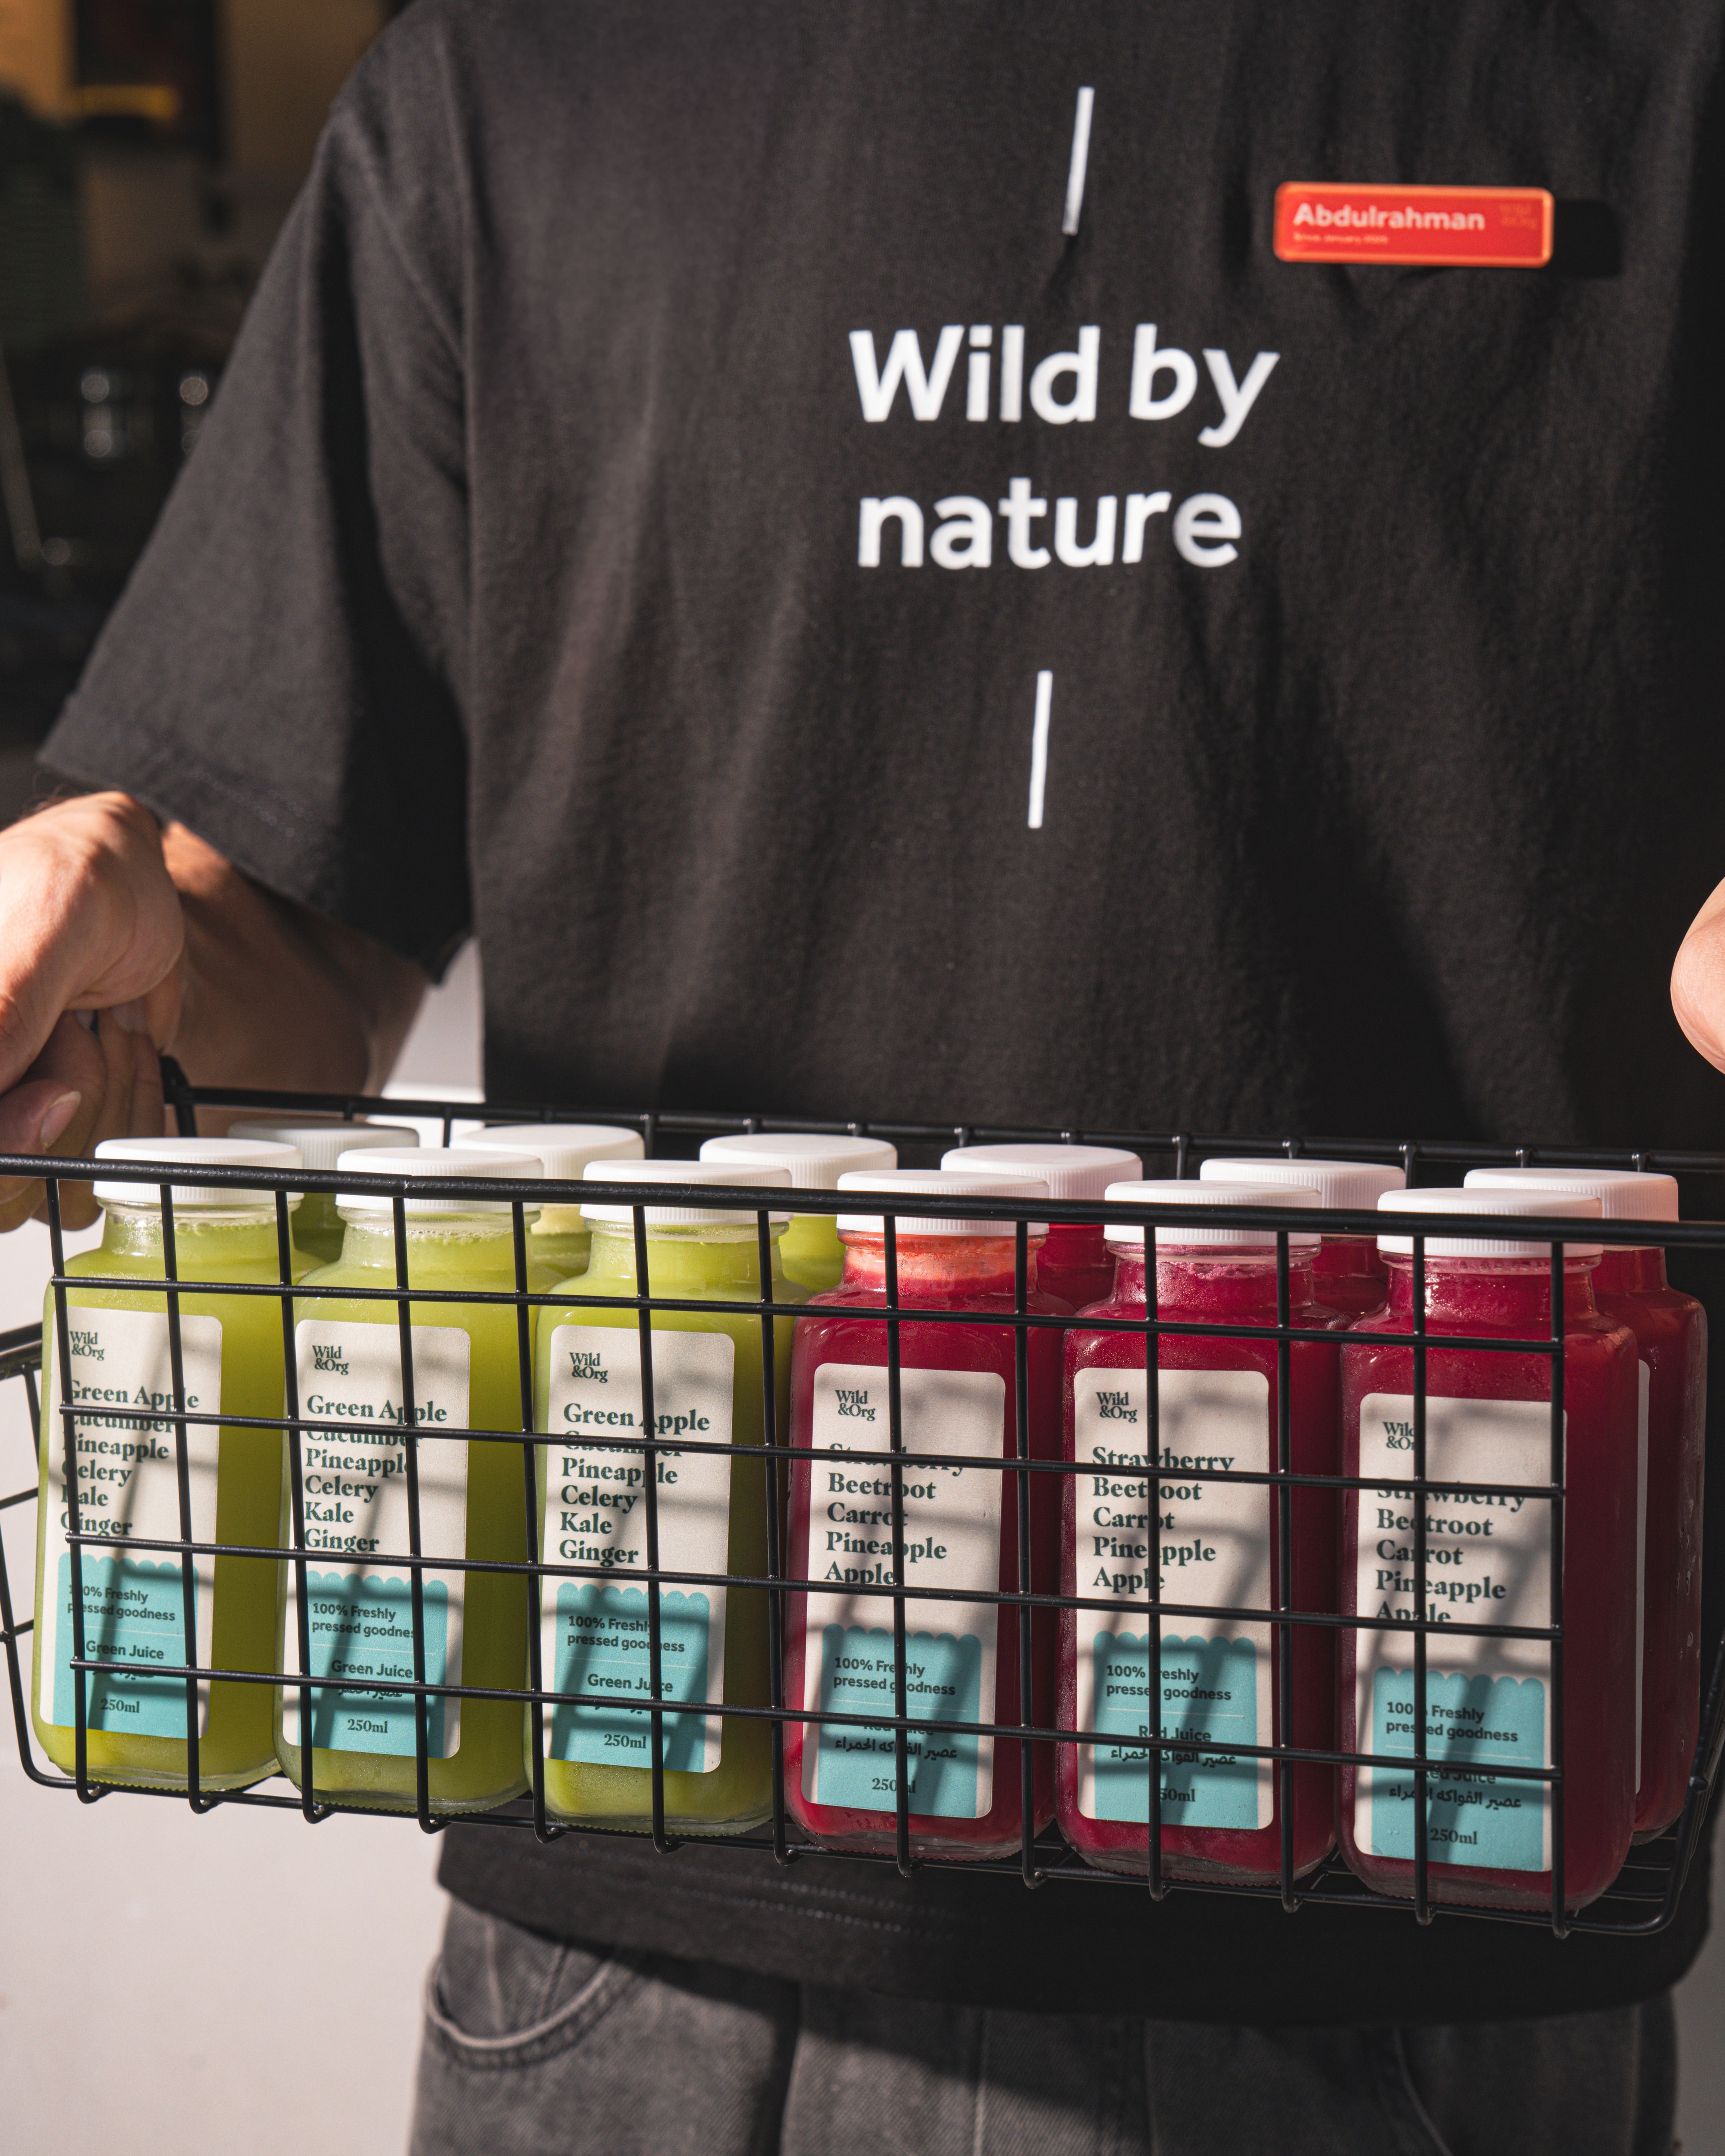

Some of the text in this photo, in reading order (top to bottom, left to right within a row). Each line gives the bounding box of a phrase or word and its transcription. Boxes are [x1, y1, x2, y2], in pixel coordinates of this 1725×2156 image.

[1293, 203, 1485, 230] Abdulrahman
[849, 323, 1280, 448] Wild by
[857, 477, 1242, 570] nature
[69, 1331, 98, 1345] Wild
[72, 1343, 105, 1361] &Org
[312, 1345, 341, 1359] Wild
[569, 1352, 601, 1366] Wild
[314, 1358, 349, 1375] &Org
[571, 1365, 608, 1383] &Org
[835, 1389, 868, 1404] Wild
[1096, 1392, 1129, 1406] Wild
[307, 1395, 374, 1418] Green
[564, 1403, 634, 1427] Green
[838, 1403, 876, 1421] &Org
[1099, 1405, 1137, 1423] &Org
[62, 1431, 169, 1463] ineapple
[1386, 1436, 1414, 1450] &Or
[305, 1448, 407, 1478] Pineappl
[62, 1459, 133, 1487] elery
[562, 1457, 678, 1488] Pineaple
[305, 1475, 379, 1503] Celery
[1092, 1476, 1203, 1500] Beetoot
[561, 1485, 638, 1513] Celery
[305, 1502, 354, 1523] Kale
[1093, 1507, 1175, 1529] Carrt
[560, 1512, 612, 1534] Kale
[305, 1529, 380, 1553] Ginger
[559, 1540, 638, 1567] Ginger
[1092, 1536, 1216, 1566] Pinepple
[1376, 1539, 1463, 1565] Carot
[824, 1561, 893, 1585] Apple
[69, 1585, 149, 1604] 10% Freshly
[67, 1603, 175, 1621] pessed goodness
[313, 1603, 396, 1622] 100% Freshly
[312, 1621, 414, 1638] pressed goodne
[569, 1615, 650, 1635] 100% Freshl
[86, 1640, 164, 1659] Green Juice
[567, 1635, 685, 1652] pressed gooess
[331, 1659, 413, 1678] Green Juice
[835, 1657, 925, 1678] 100% Frehly
[1107, 1665, 1199, 1683] 100% eshly
[588, 1673, 673, 1692] Green Jue
[834, 1677, 955, 1695] pressed godness
[1106, 1684, 1231, 1701] presse goodness
[101, 1698, 140, 1713] 250ml
[1387, 1701, 1485, 1724] 100 Freshly
[347, 1719, 389, 1733] 250ml
[1139, 1725, 1212, 1741] Rd Juice
[1446, 1727, 1518, 1742] goodness
[604, 1733, 646, 1749] 250ml
[835, 1736, 876, 1752] الحمراء
[924, 1748, 957, 1761] عصير
[1202, 1756, 1236, 1768] عصير
[872, 1778, 916, 1793] 250l
[1160, 1788, 1196, 1802] 50ml
[1436, 1789, 1483, 1806] الفواكه
[1486, 1798, 1522, 1810] عصير
[1430, 1828, 1477, 1845] 250ml
